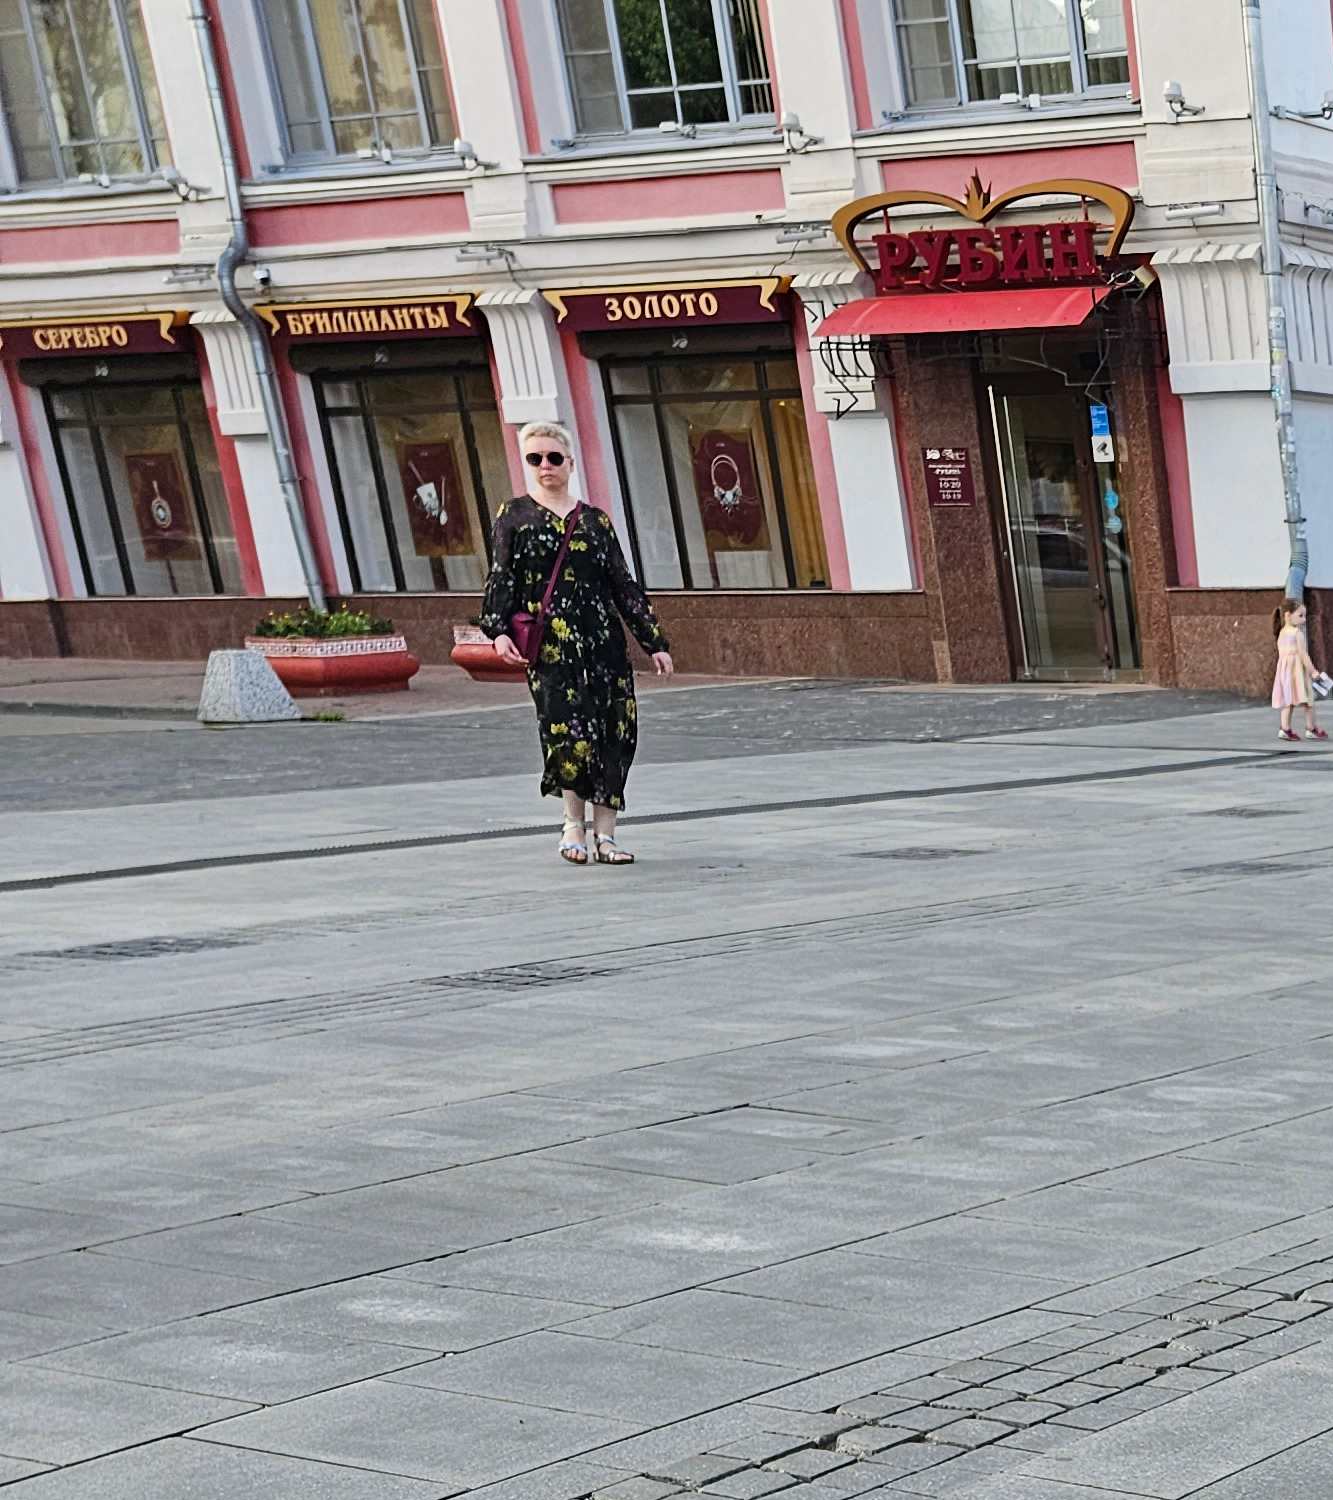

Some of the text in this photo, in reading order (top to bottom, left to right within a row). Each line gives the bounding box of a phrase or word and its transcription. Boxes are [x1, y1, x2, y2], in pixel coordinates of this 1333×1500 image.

[872, 221, 1100, 289] РУБИН
[286, 306, 449, 335] БРИЛЛИАНТЫ
[605, 292, 718, 321] ЗОЛОТО
[34, 325, 128, 350] СЕРЕБРО
